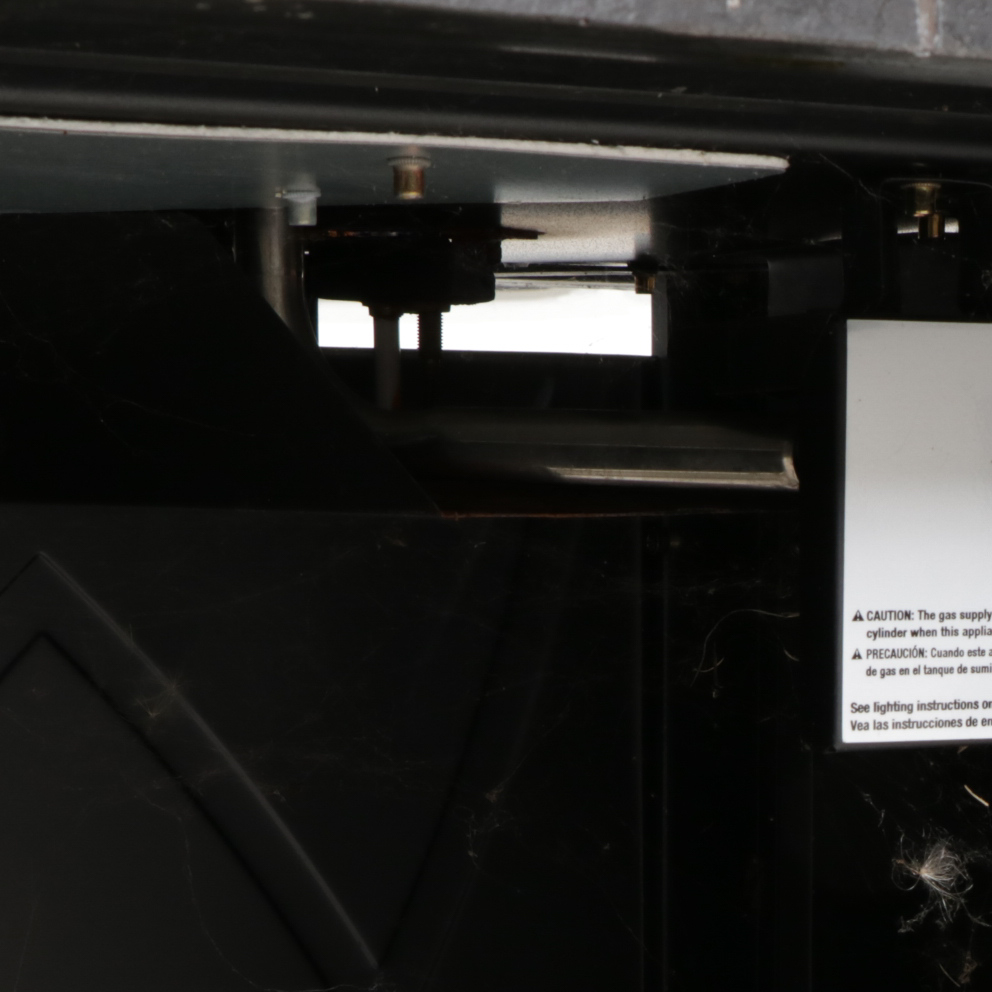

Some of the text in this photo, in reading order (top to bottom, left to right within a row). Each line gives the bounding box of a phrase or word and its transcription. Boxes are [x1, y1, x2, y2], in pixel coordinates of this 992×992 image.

[866, 610, 915, 621] CAUTION:
[918, 610, 935, 620] The
[938, 612, 956, 622] gas
[959, 609, 992, 622] supply
[866, 628, 906, 641] cylinder
[910, 627, 937, 638] when
[940, 627, 958, 637] this
[850, 703, 870, 713] See
[873, 702, 913, 714] lighting
[916, 700, 979, 711] instructions
[850, 721, 869, 731] Vea
[872, 720, 888, 730] las
[891, 718, 962, 730] instrucciones
[965, 717, 978, 727] de
